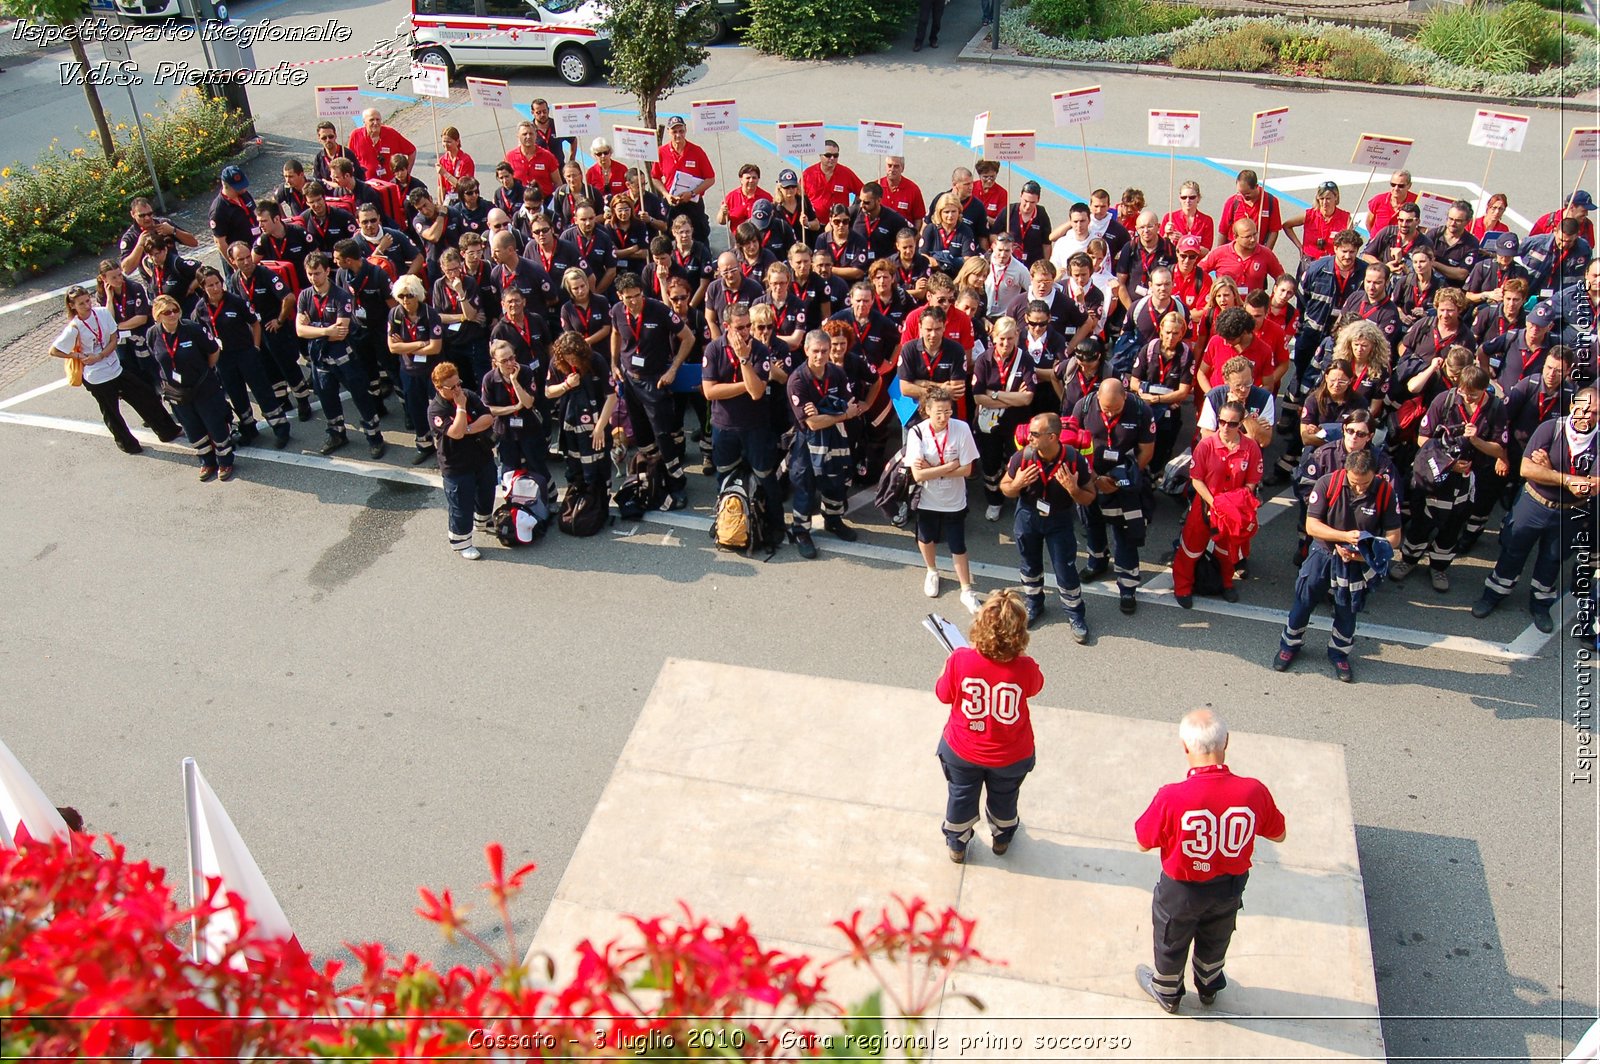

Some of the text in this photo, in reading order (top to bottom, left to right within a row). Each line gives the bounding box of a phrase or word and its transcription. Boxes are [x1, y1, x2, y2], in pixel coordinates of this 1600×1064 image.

[960, 676, 1023, 726] 30
[969, 720, 986, 732] 30
[1181, 806, 1256, 860] 30
[1193, 861, 1211, 873] 30
